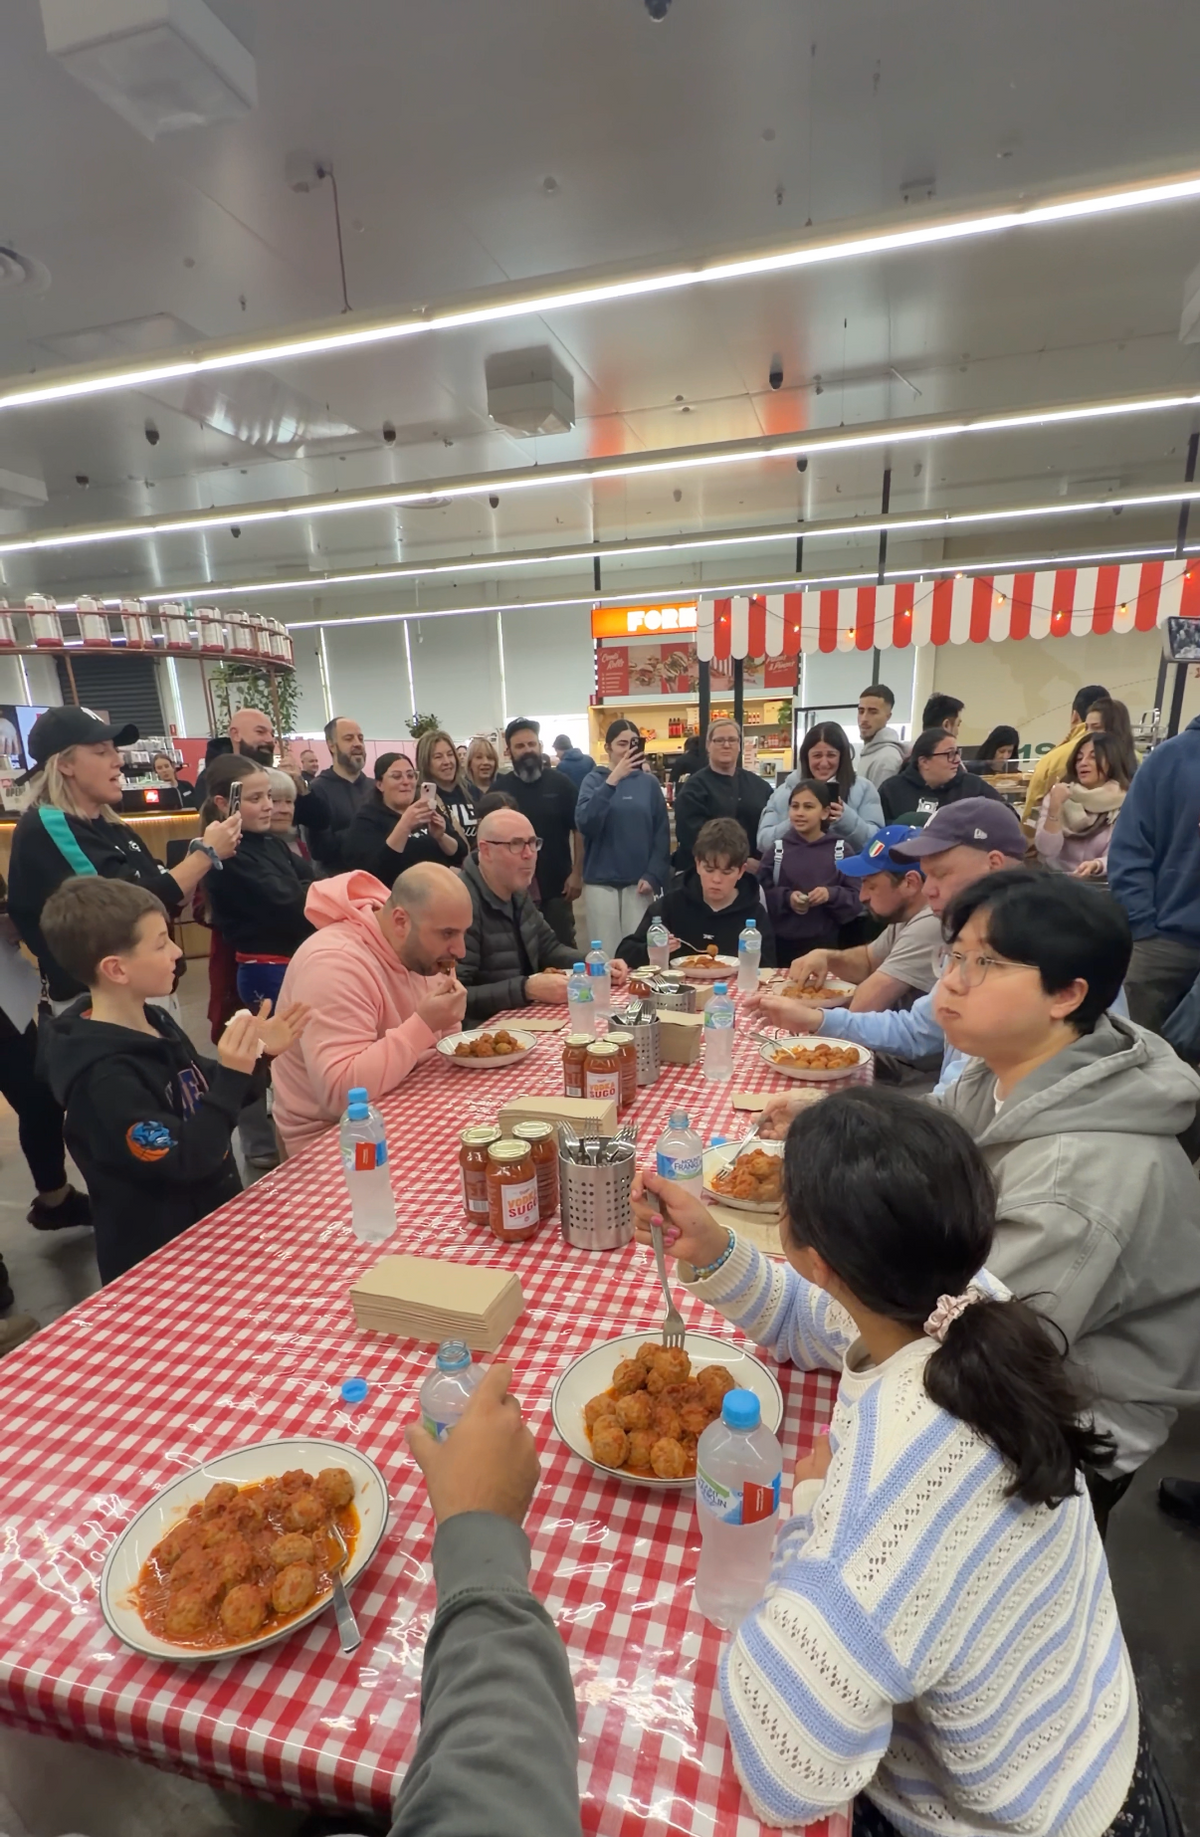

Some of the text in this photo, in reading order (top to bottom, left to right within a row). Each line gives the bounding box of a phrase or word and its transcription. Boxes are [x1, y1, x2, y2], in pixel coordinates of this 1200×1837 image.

[589, 1081, 615, 1091] VODKA
[589, 1088, 616, 1098] SUGO
[507, 1189, 537, 1209] VODK
